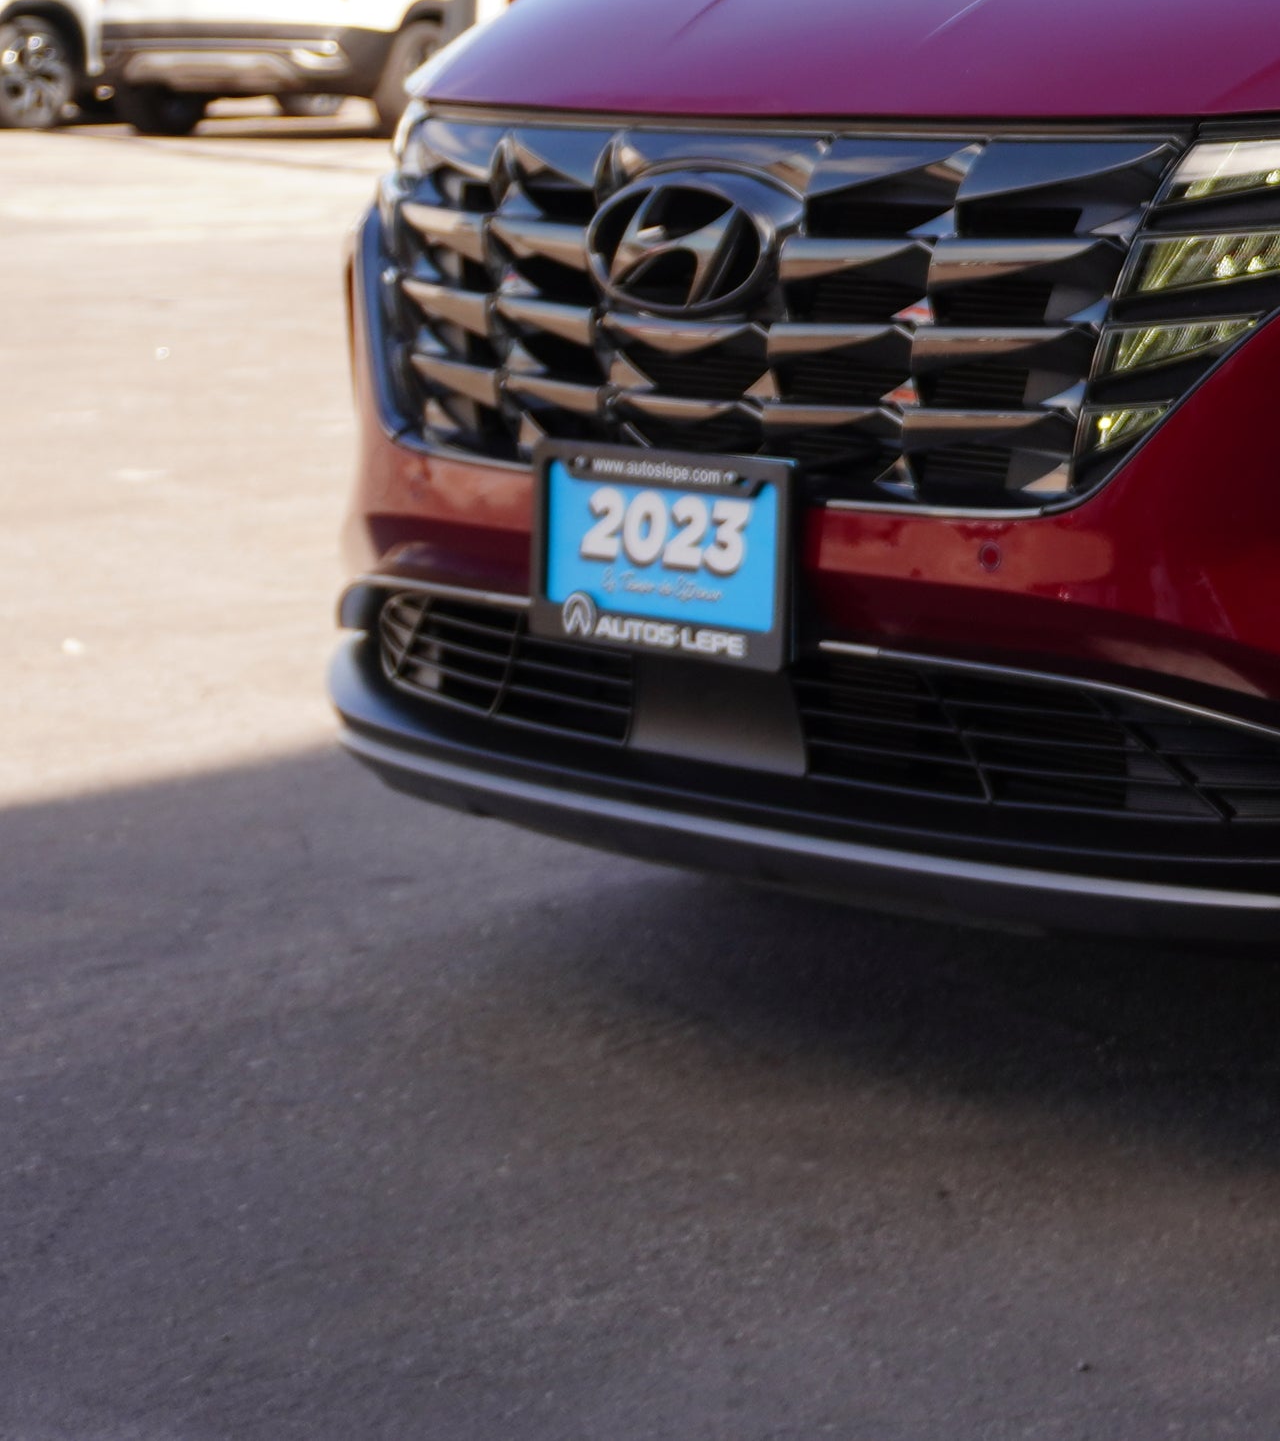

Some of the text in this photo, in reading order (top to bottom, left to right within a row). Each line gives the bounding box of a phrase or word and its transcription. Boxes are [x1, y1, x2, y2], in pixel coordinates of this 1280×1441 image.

[592, 457, 721, 484] www.autoslepe.com
[580, 486, 752, 577] 2023
[594, 614, 748, 658] AUTOS LEPE
